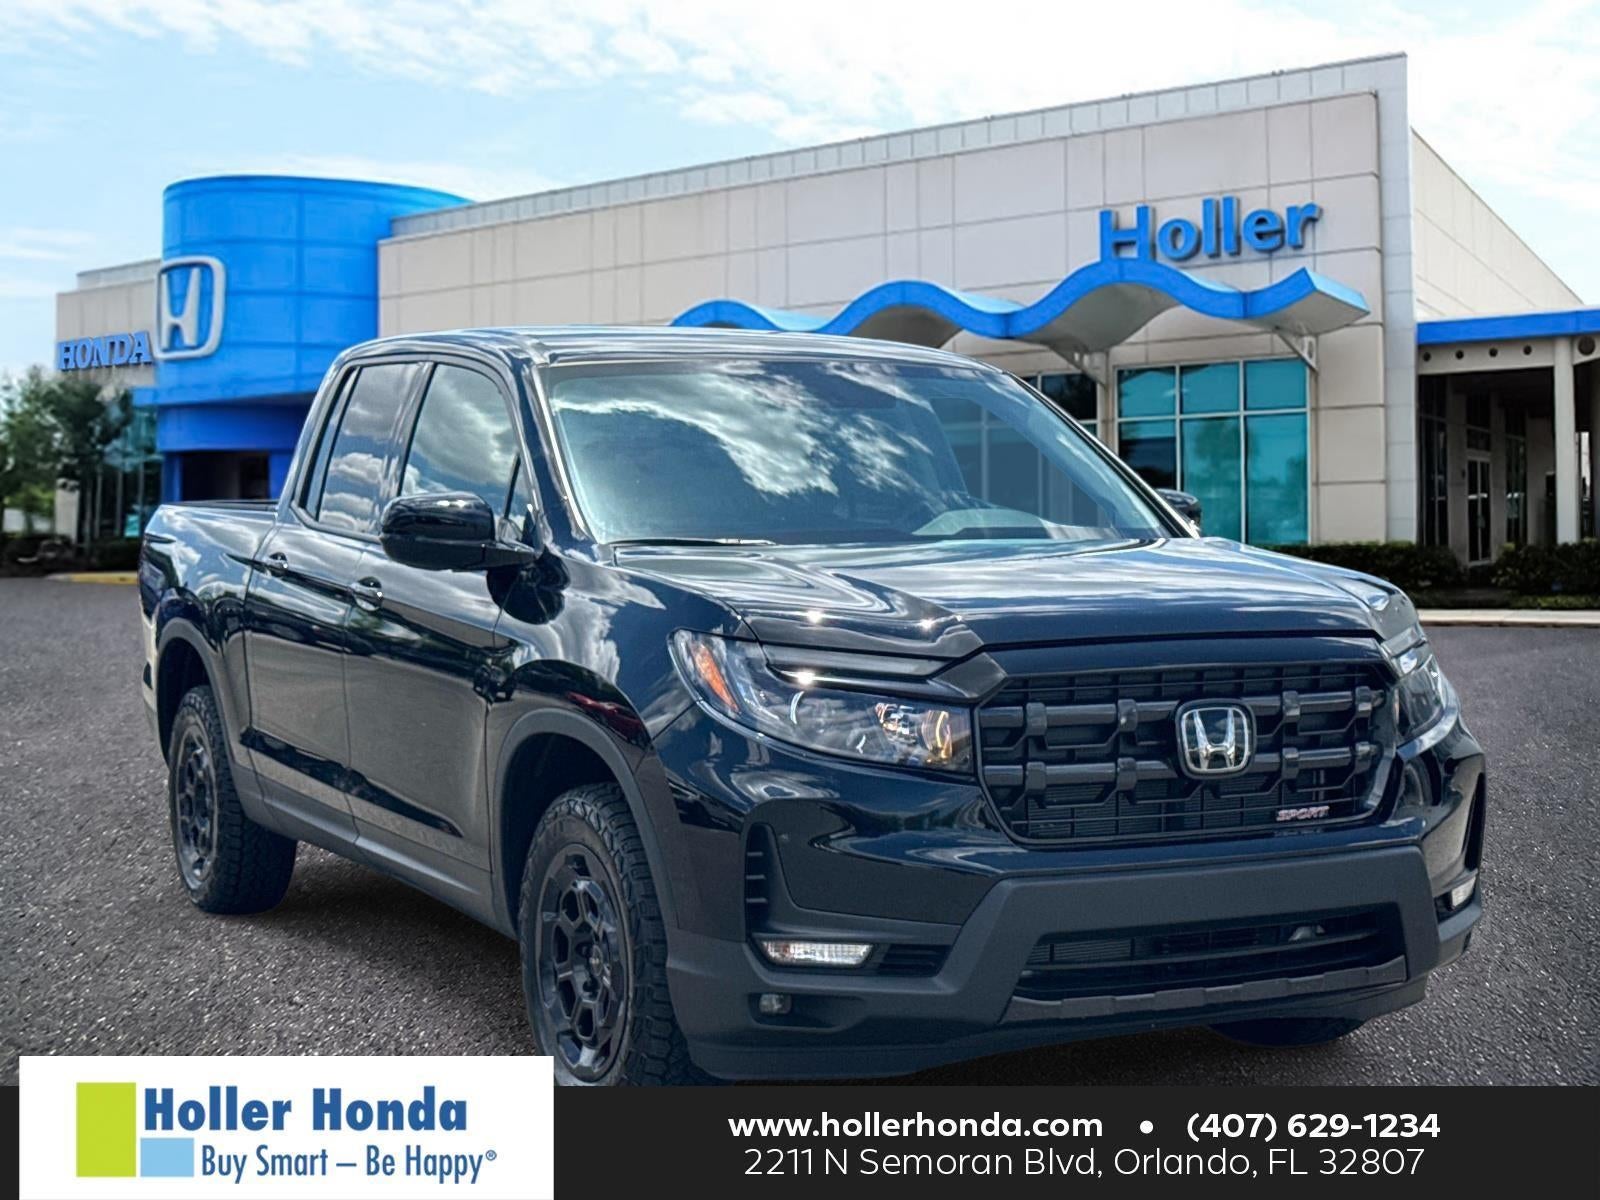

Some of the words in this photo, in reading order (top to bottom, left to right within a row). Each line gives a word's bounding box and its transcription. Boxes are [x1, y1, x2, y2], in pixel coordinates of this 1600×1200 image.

[1099, 196, 1321, 261] Holler
[57, 331, 152, 371] HONDA
[1276, 805, 1330, 821] SPORT
